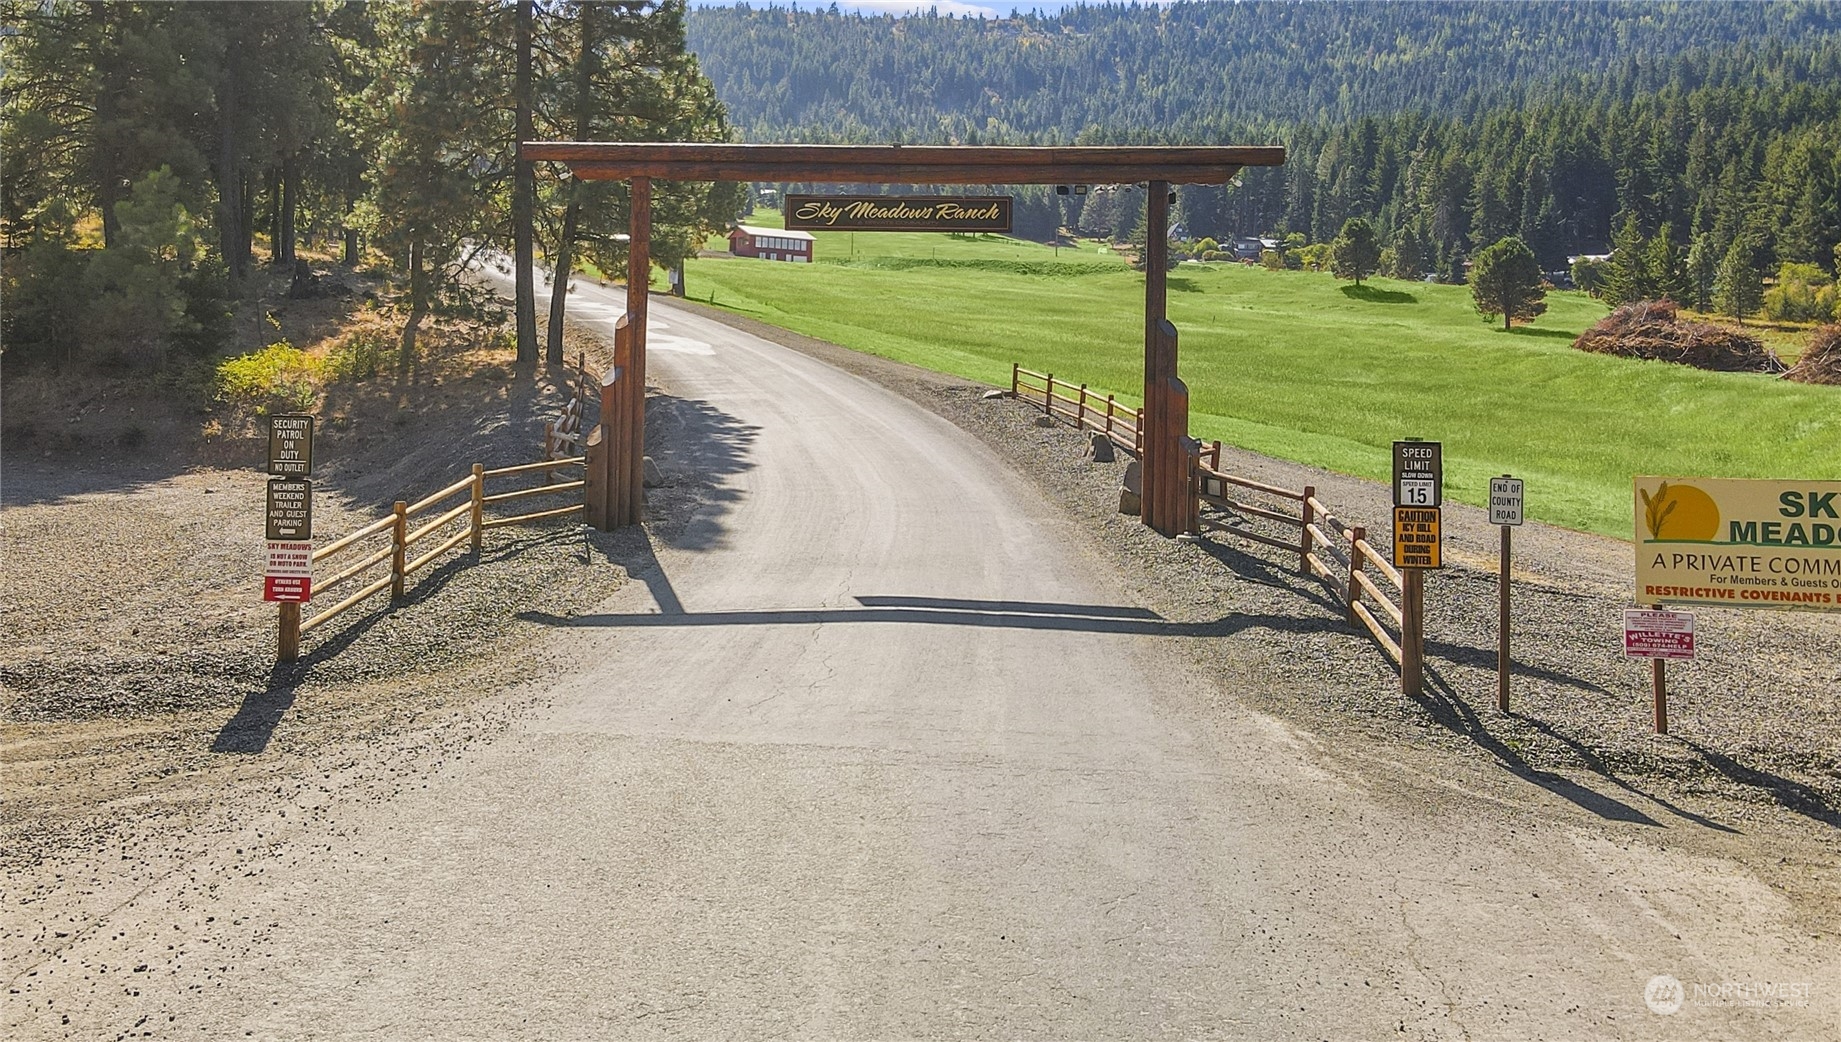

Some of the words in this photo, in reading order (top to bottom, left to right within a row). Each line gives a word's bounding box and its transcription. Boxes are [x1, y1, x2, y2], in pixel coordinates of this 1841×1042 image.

[796, 201, 843, 226] Sky
[844, 201, 933, 219] Meadows
[936, 202, 1000, 220] Ranch
[273, 419, 309, 429] SECURITY
[276, 430, 304, 440] PATROL
[283, 440, 294, 450] ON
[280, 450, 299, 460] DUTY
[1402, 448, 1433, 458] SPEED
[274, 463, 282, 472] NO
[284, 463, 304, 472] OUTLET
[1404, 460, 1431, 471] LIMIT
[272, 483, 305, 491] MEMBERS
[1492, 483, 1508, 493] END
[1511, 484, 1521, 493] OF
[273, 492, 304, 500] WEEKEND
[275, 501, 302, 509] TRAILER
[1492, 496, 1521, 507] COUNTY
[1778, 490, 1841, 519] SK
[269, 510, 284, 518] AND
[286, 510, 307, 518] GUEST
[1398, 510, 1437, 522] CAUTION
[1496, 509, 1517, 520] ROAD
[273, 519, 303, 527] PARKING
[1402, 523, 1415, 532] ICY
[1416, 523, 1432, 533] HILL
[1729, 520, 1841, 546] MEAD
[1399, 534, 1414, 543] AND
[1415, 534, 1436, 543] ROAD
[1403, 544, 1431, 554] DURING
[1402, 555, 1432, 565] WINTER
[1651, 553, 1667, 569] A
[1672, 553, 1762, 573] PRIVATE
[1709, 574, 1728, 584] For
[1730, 575, 1777, 587] Members
[1780, 577, 1788, 587] &
[1791, 577, 1828, 588] Guests
[1831, 579, 1841, 589] O
[1645, 585, 1736, 599] RESTRICTIVE
[1740, 589, 1831, 604] COVENANTS
[1628, 631, 1692, 643] WILLETTE'S
